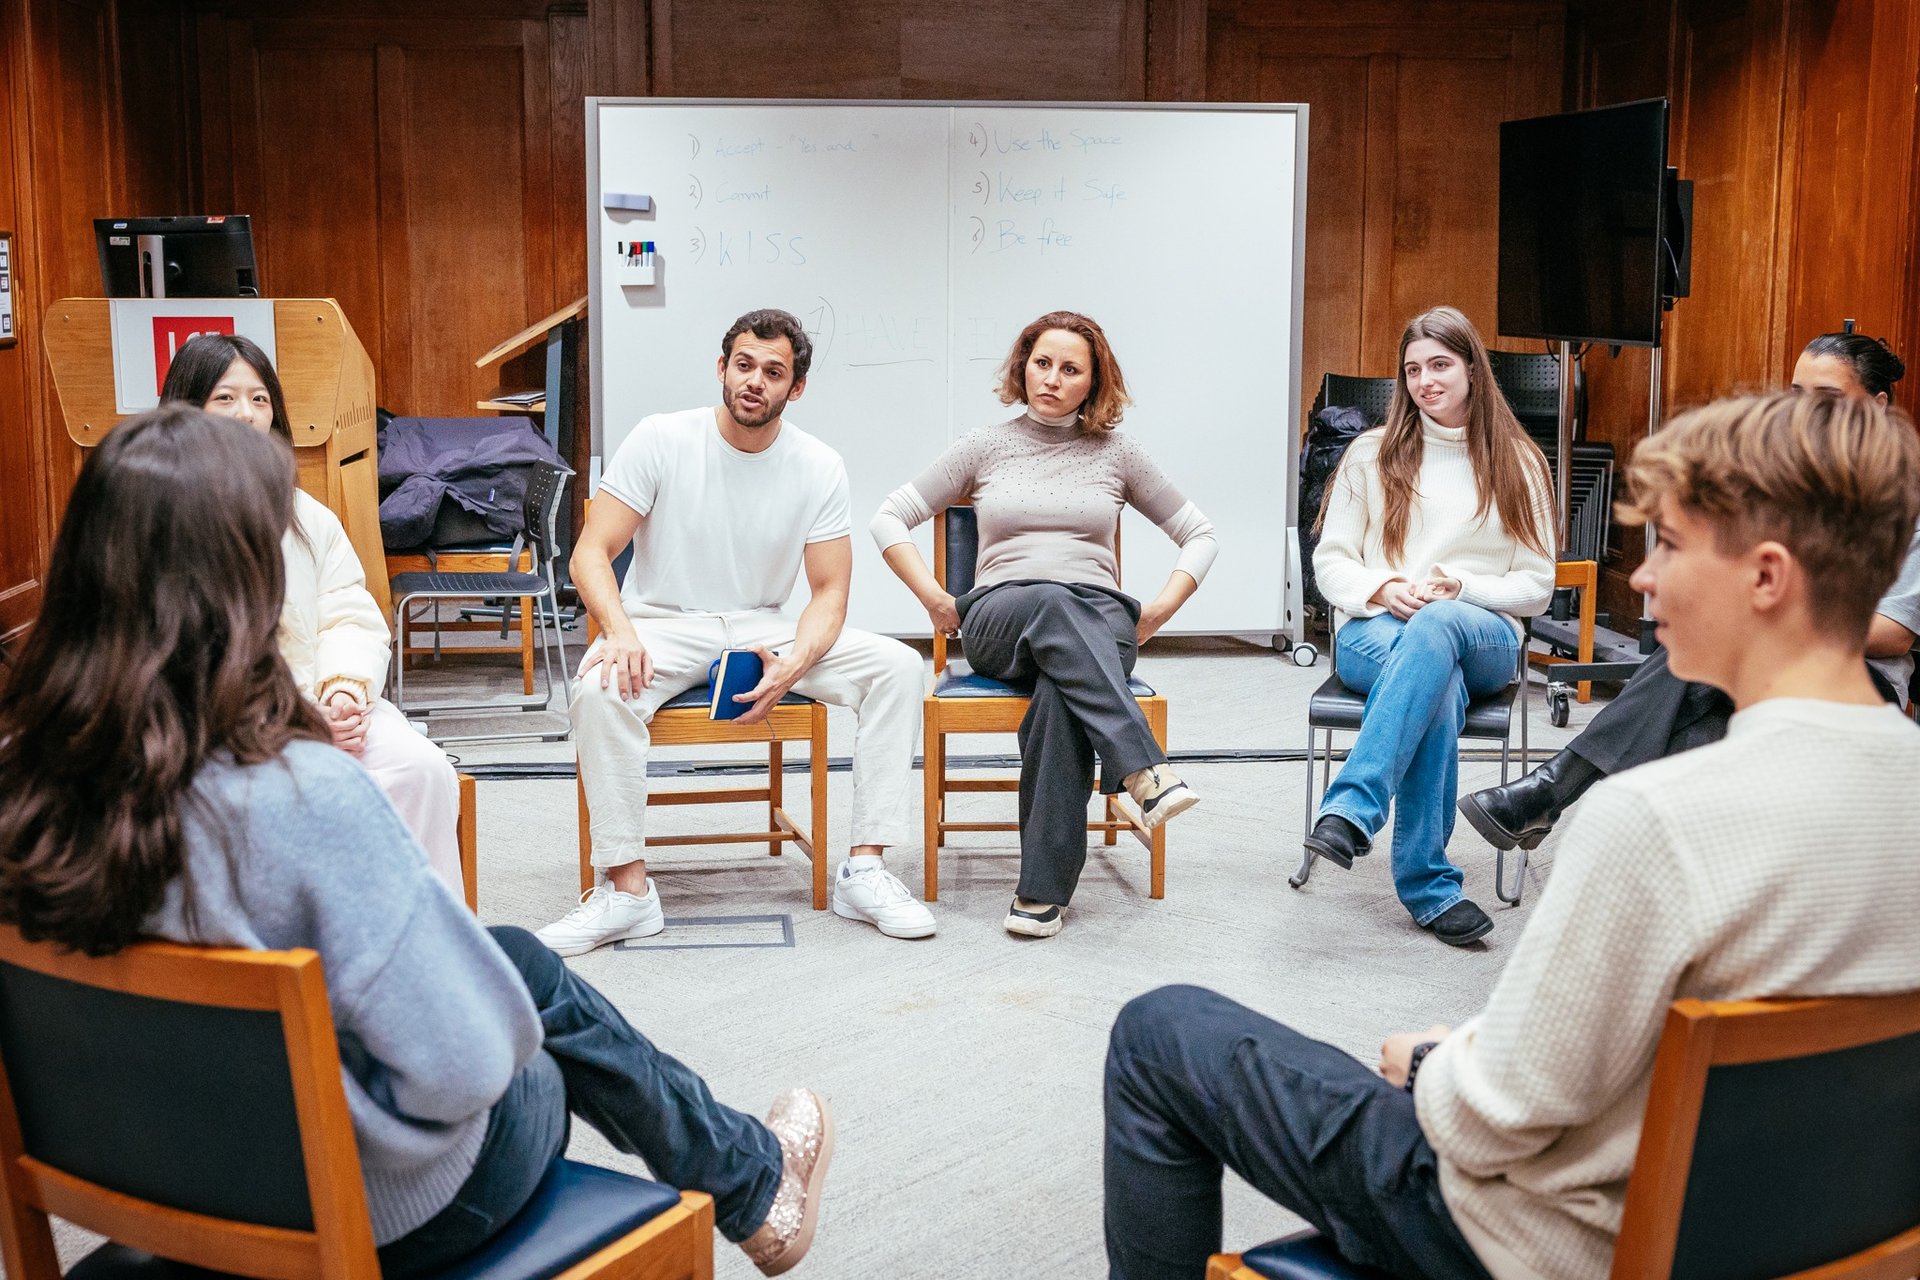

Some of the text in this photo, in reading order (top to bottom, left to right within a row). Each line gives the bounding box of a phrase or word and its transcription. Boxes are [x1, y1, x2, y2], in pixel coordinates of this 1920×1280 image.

[715, 137, 766, 157] Accept
[994, 127, 1032, 154] Use
[1037, 128, 1062, 151] the
[1069, 128, 1123, 155] Space
[688, 173, 772, 209] 2) Commit
[999, 171, 1042, 207] Keep
[1054, 175, 1066, 201] it
[1083, 178, 1128, 208] Safe
[688, 226, 707, 265] 3)
[991, 219, 1027, 254] Be
[1037, 217, 1074, 256] free
